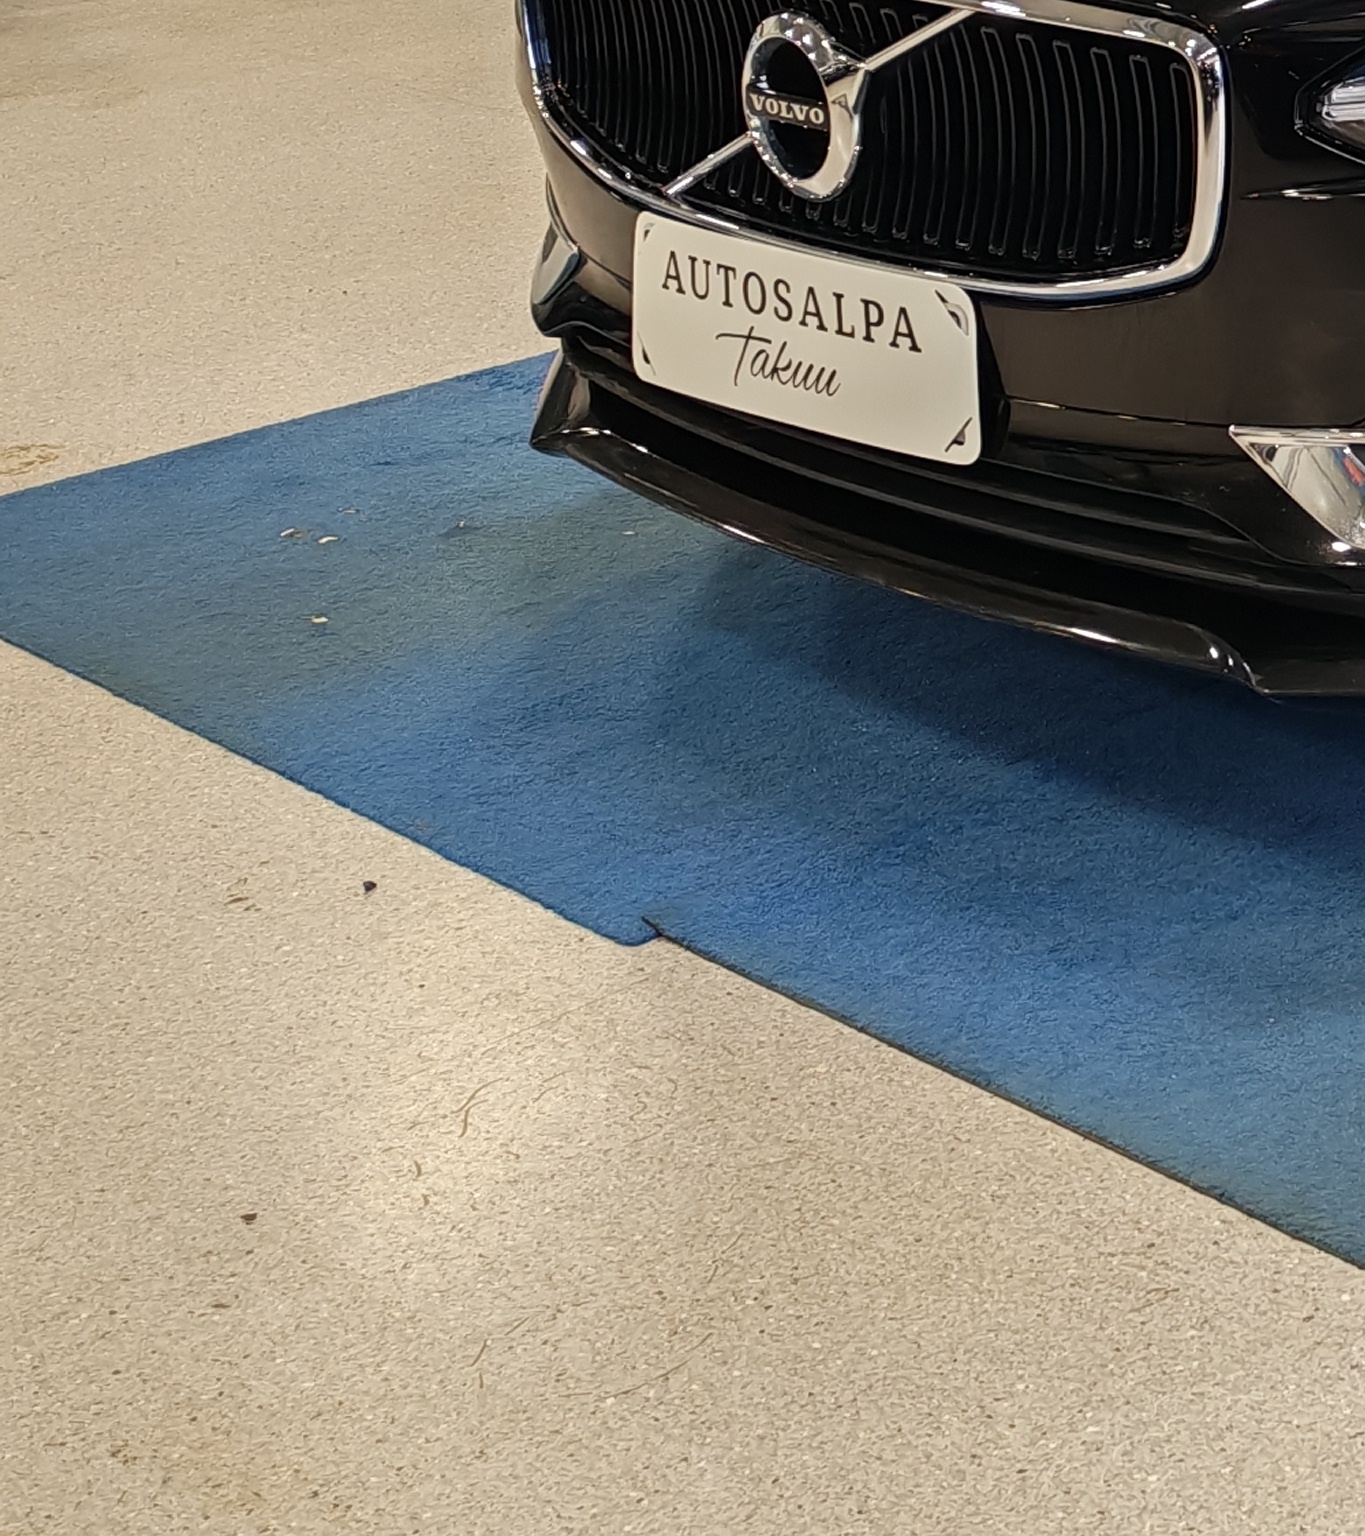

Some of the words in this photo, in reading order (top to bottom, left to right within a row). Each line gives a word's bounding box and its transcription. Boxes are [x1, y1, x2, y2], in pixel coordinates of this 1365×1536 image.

[750, 93, 825, 125] VOLVO
[661, 250, 923, 354] AUTOSALPA
[715, 325, 842, 397] Takuu
